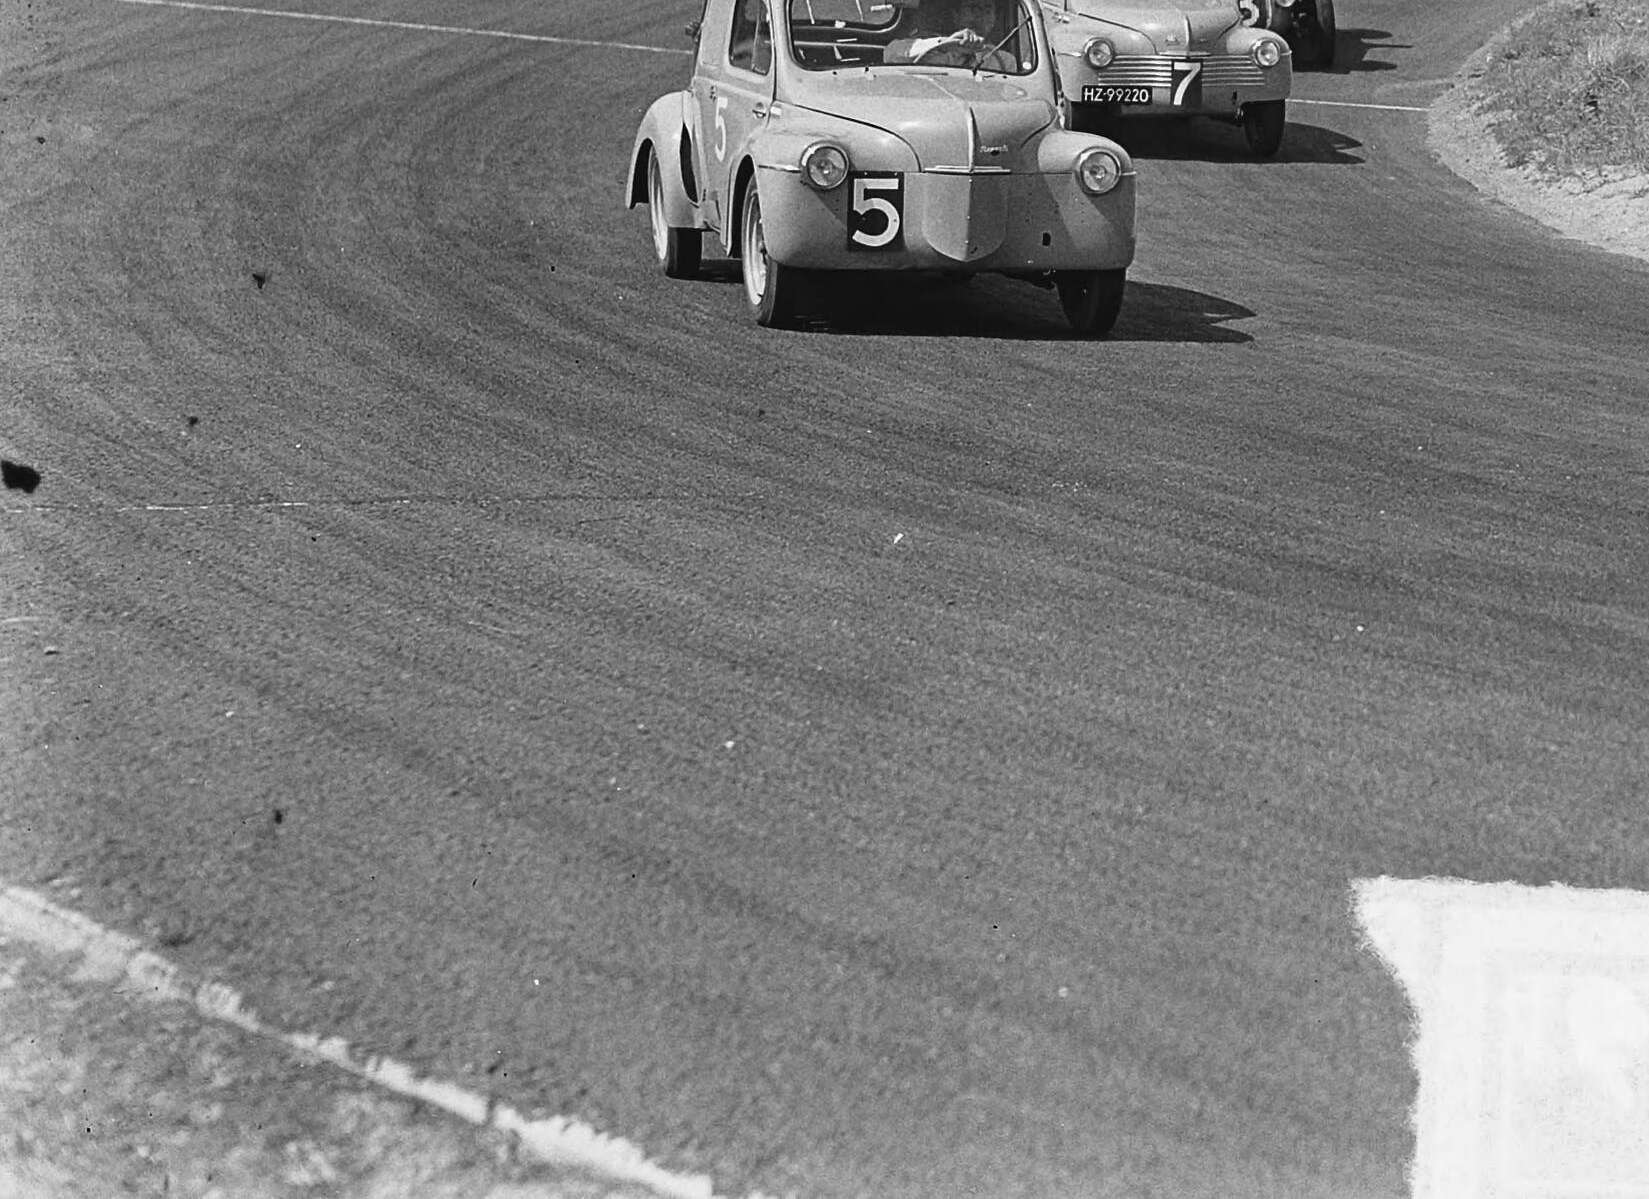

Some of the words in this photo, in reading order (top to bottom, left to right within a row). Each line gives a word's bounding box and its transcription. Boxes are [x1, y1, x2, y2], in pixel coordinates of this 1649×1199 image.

[1174, 62, 1201, 105] 7
[715, 97, 728, 162] 5
[853, 178, 900, 247] 5
